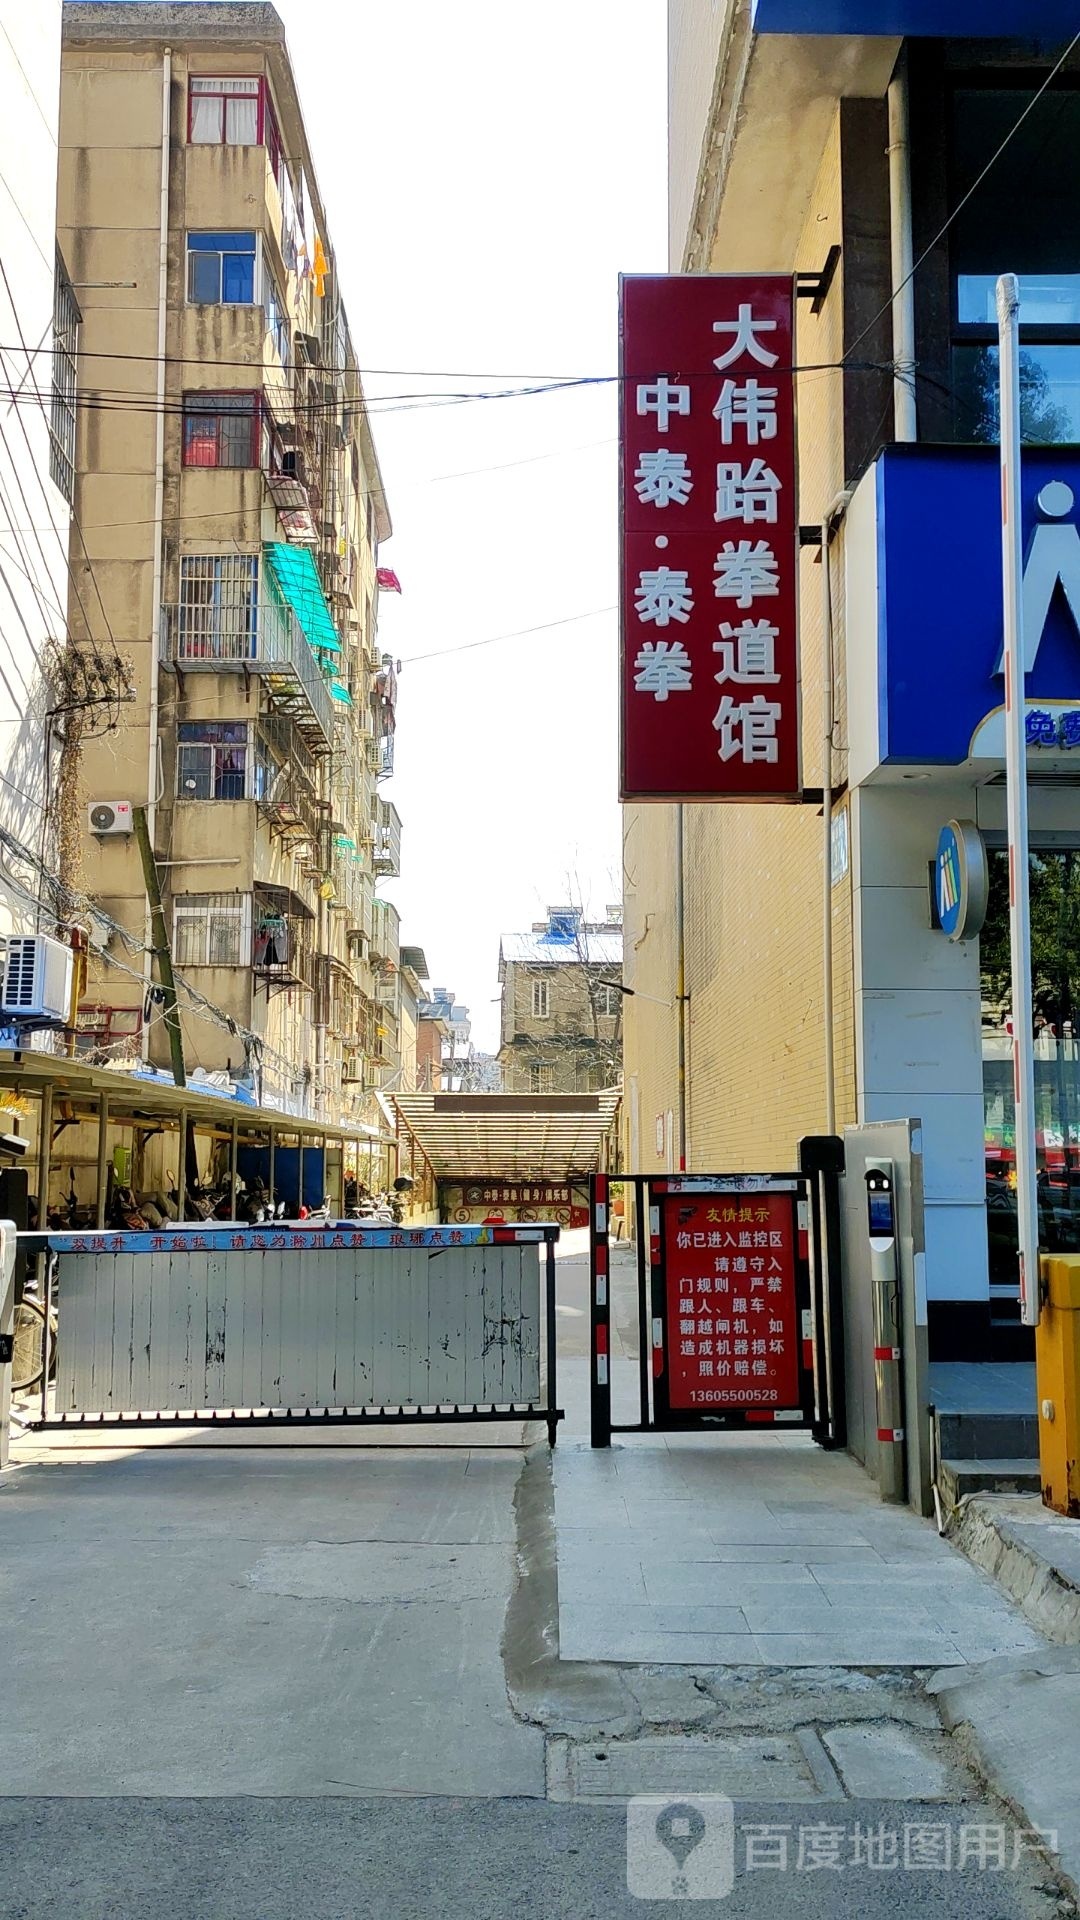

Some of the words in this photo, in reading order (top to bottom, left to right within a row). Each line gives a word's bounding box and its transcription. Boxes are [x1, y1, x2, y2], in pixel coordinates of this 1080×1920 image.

[634, 377, 695, 702] 中泰·泰拳
[712, 304, 782, 764] 大伟跆拳道馆
[706, 1207, 770, 1222] 友情提示
[676, 1231, 783, 1249] 你已进入监控区
[714, 1256, 783, 1273] 请遵守入
[680, 1339, 785, 1356] 造成机器损坏
[689, 1389, 778, 1402] 13605500528
